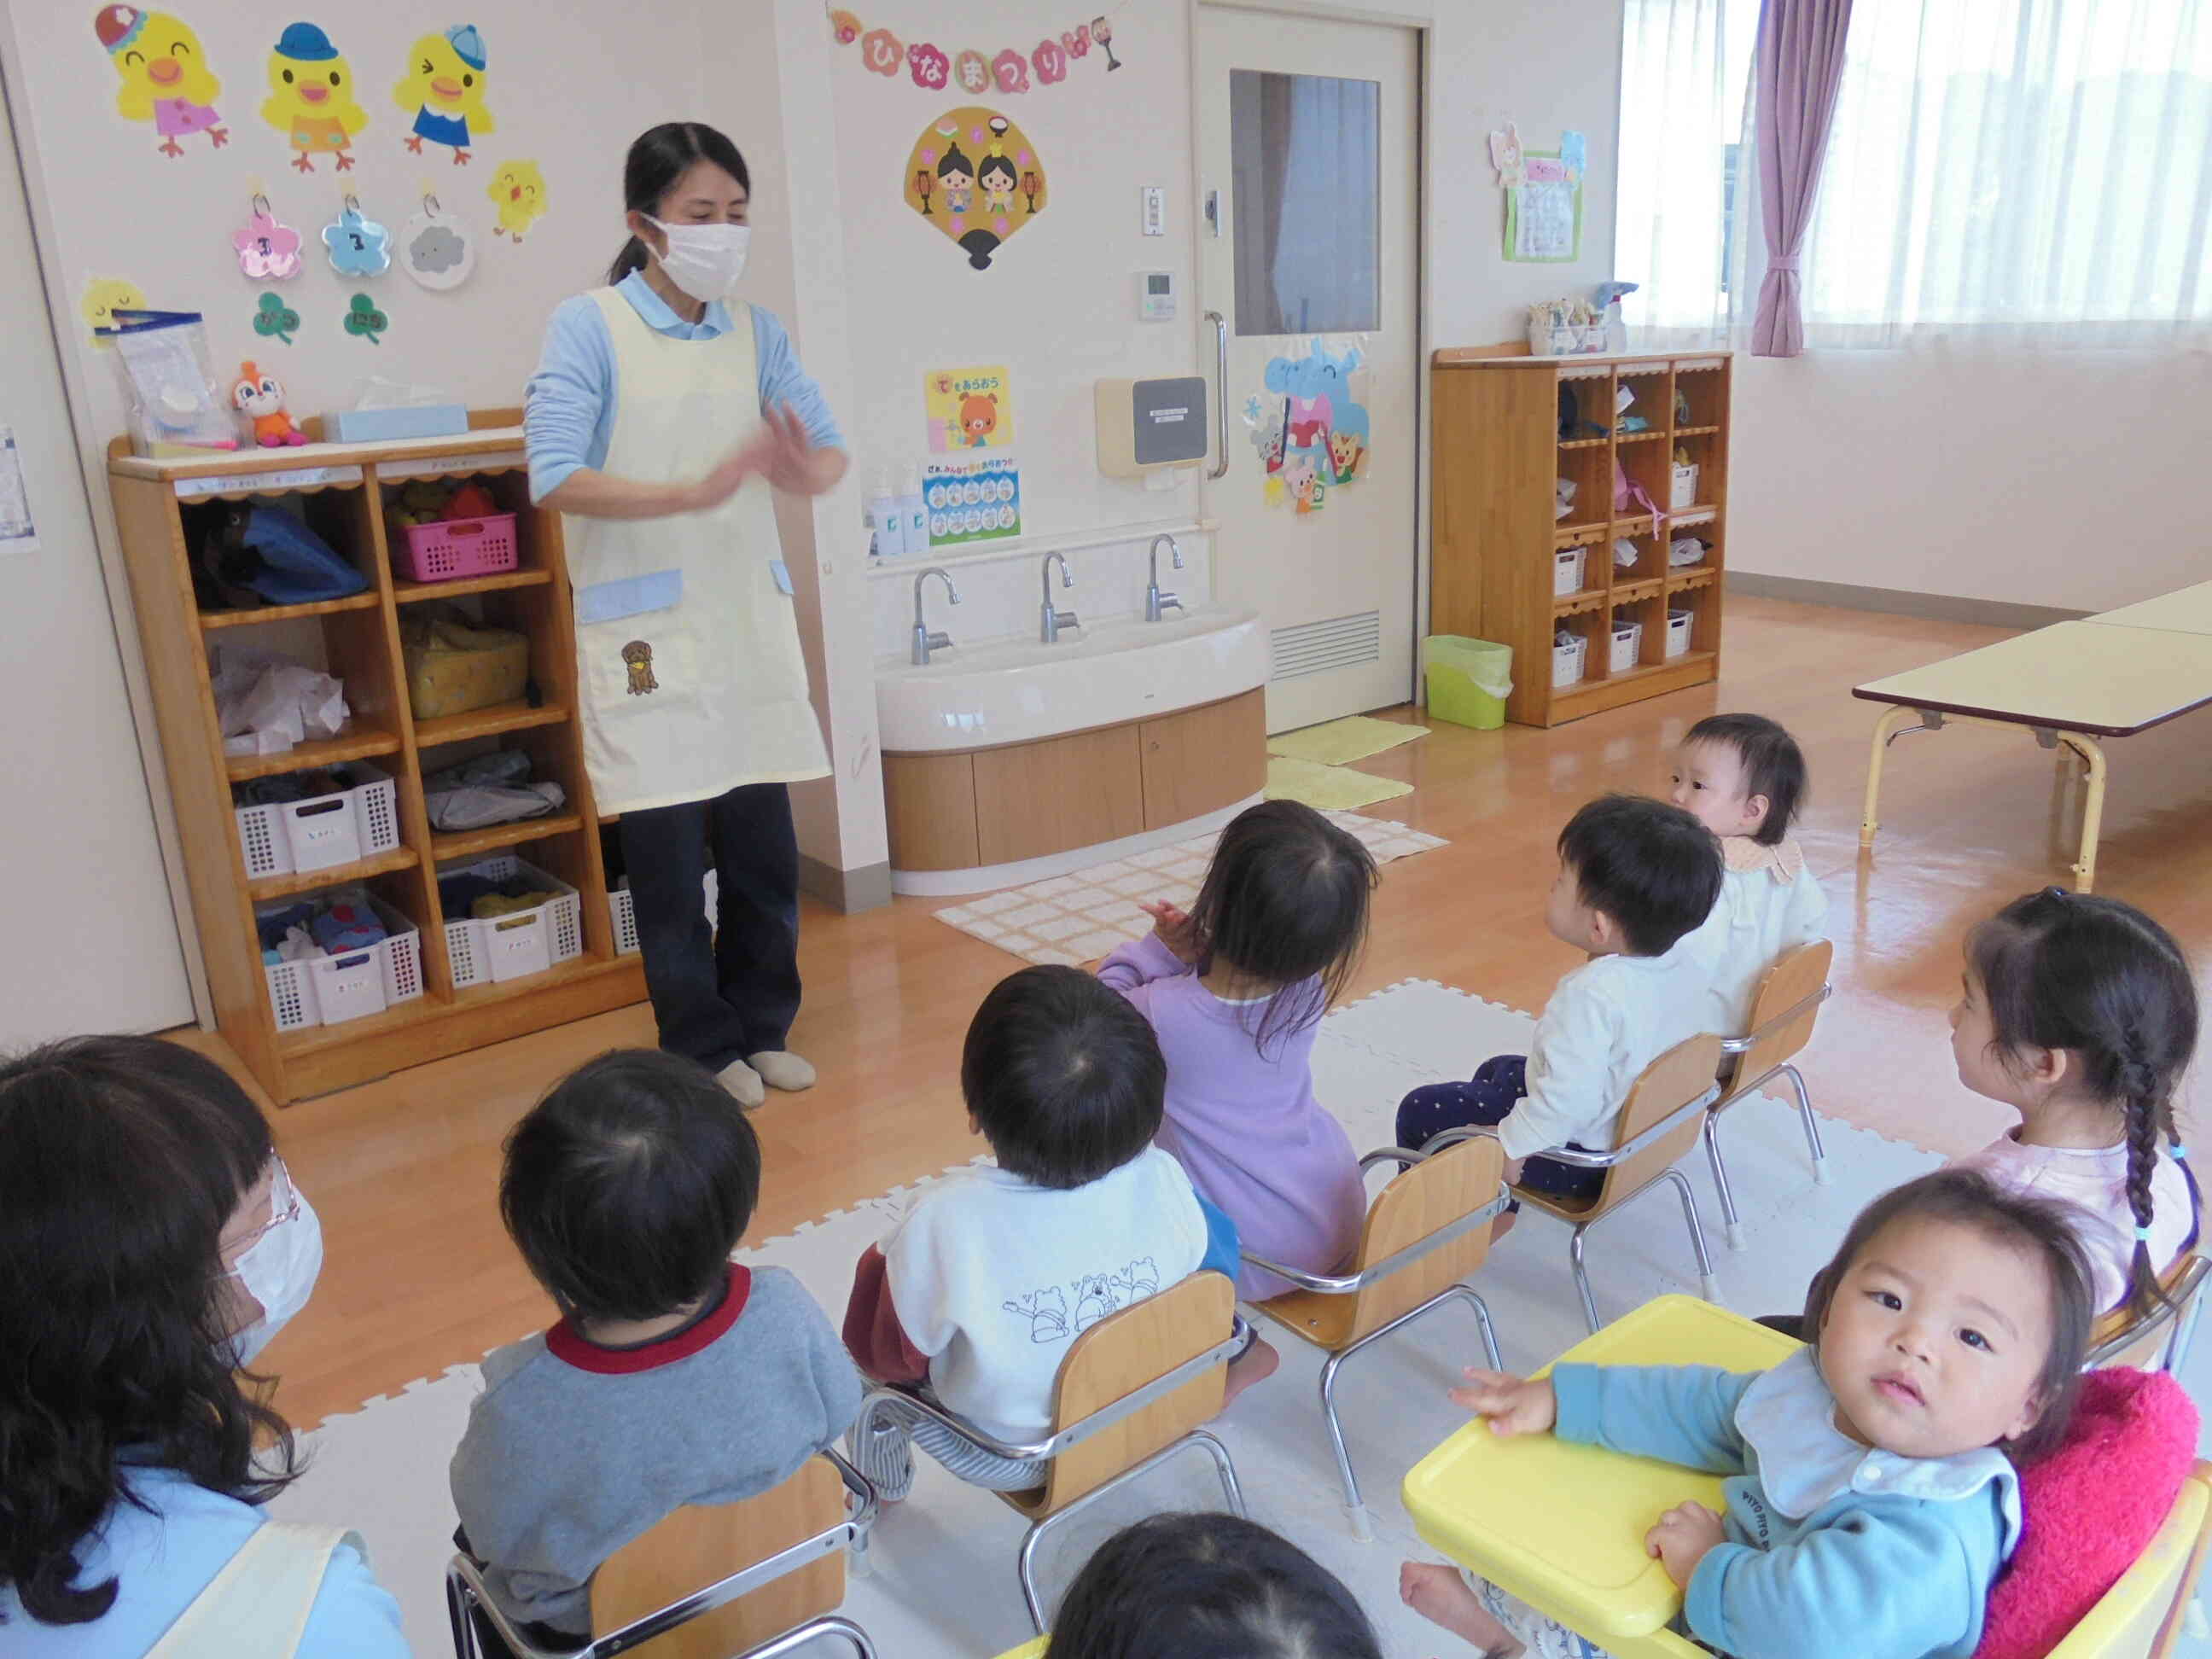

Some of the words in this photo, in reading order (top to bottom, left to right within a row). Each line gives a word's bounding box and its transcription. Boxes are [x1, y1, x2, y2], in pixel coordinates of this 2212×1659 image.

[872, 39, 1059, 86] ひなまつり
[1742, 1490, 1763, 1513] PIYO
[1755, 1513, 1769, 1537] PIYO
